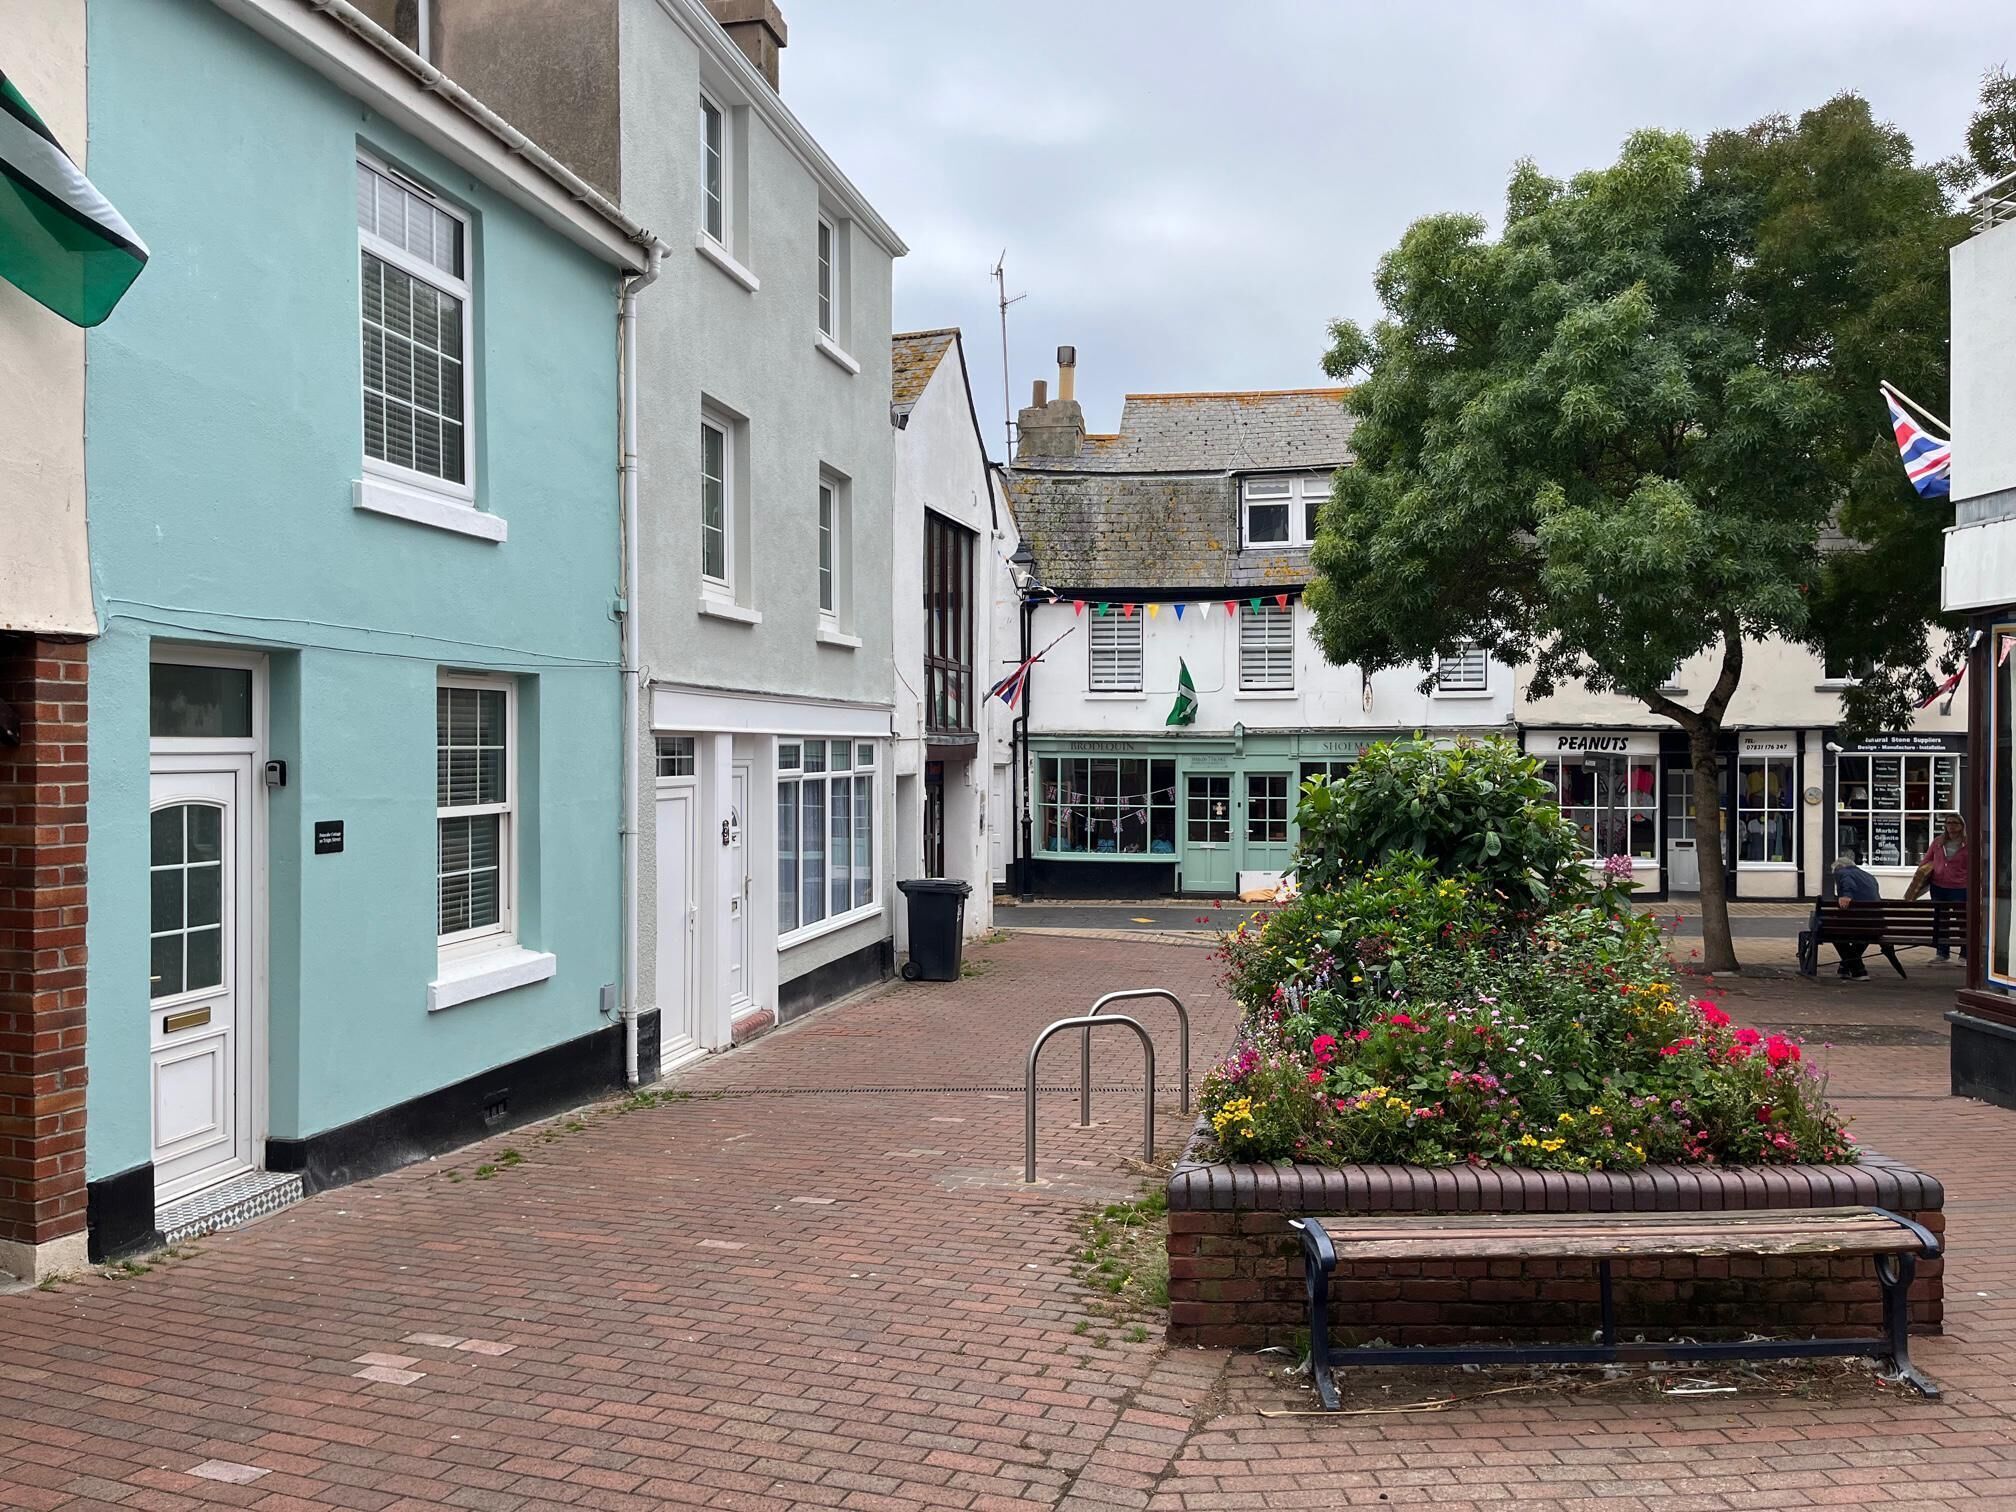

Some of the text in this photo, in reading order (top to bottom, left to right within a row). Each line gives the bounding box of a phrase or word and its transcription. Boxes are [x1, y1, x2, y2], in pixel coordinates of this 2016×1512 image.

[1071, 742, 1134, 751] BRODEQUIN
[1322, 742, 1371, 751] SHOEMA
[1558, 736, 1629, 751] PEANUTS
